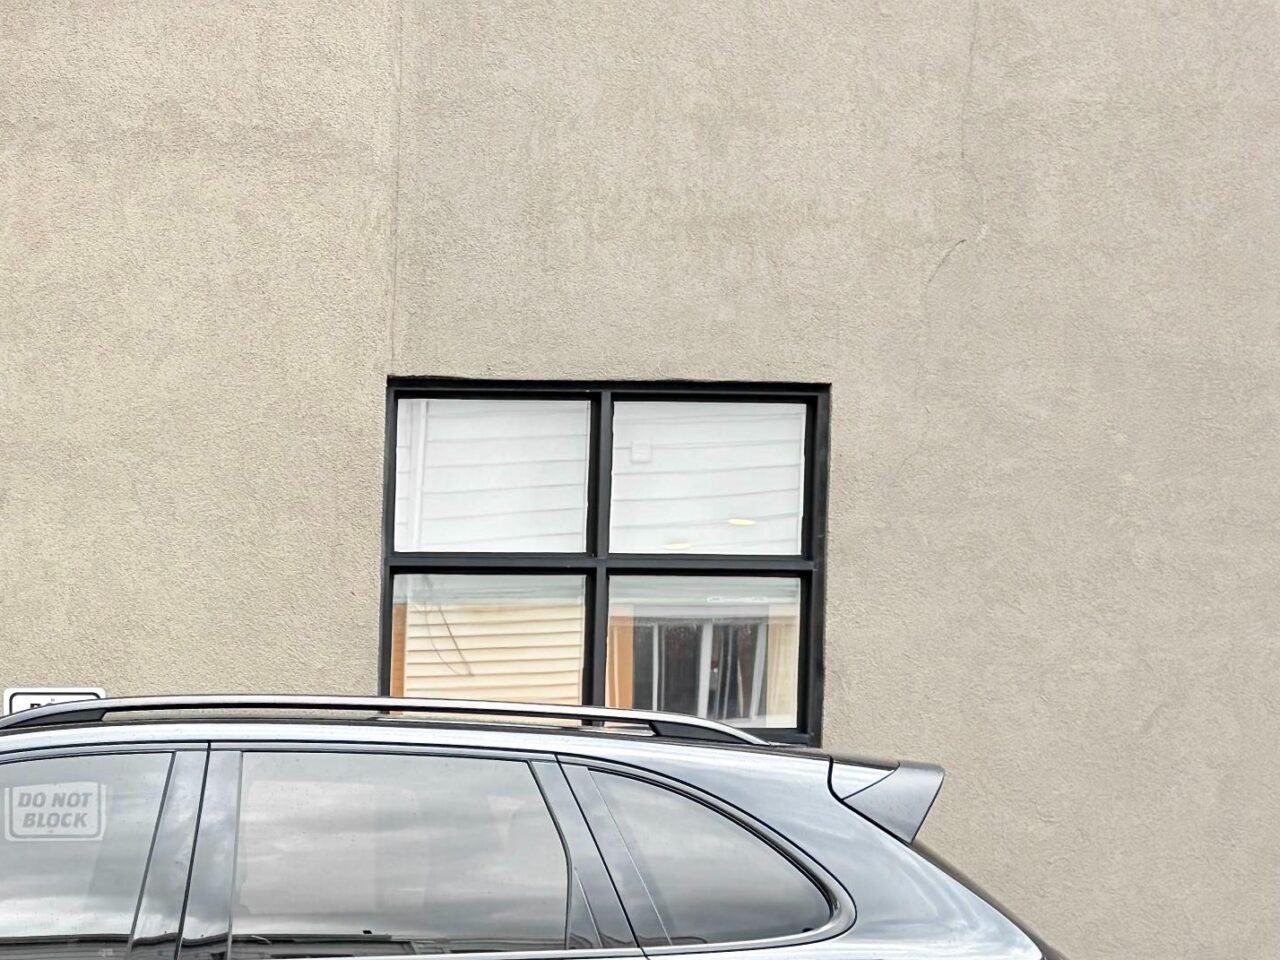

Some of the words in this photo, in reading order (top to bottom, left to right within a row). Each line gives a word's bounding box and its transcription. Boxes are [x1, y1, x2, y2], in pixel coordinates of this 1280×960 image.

[18, 792, 46, 807] DO
[52, 792, 93, 807] NOT
[22, 812, 88, 828] BLOCK
